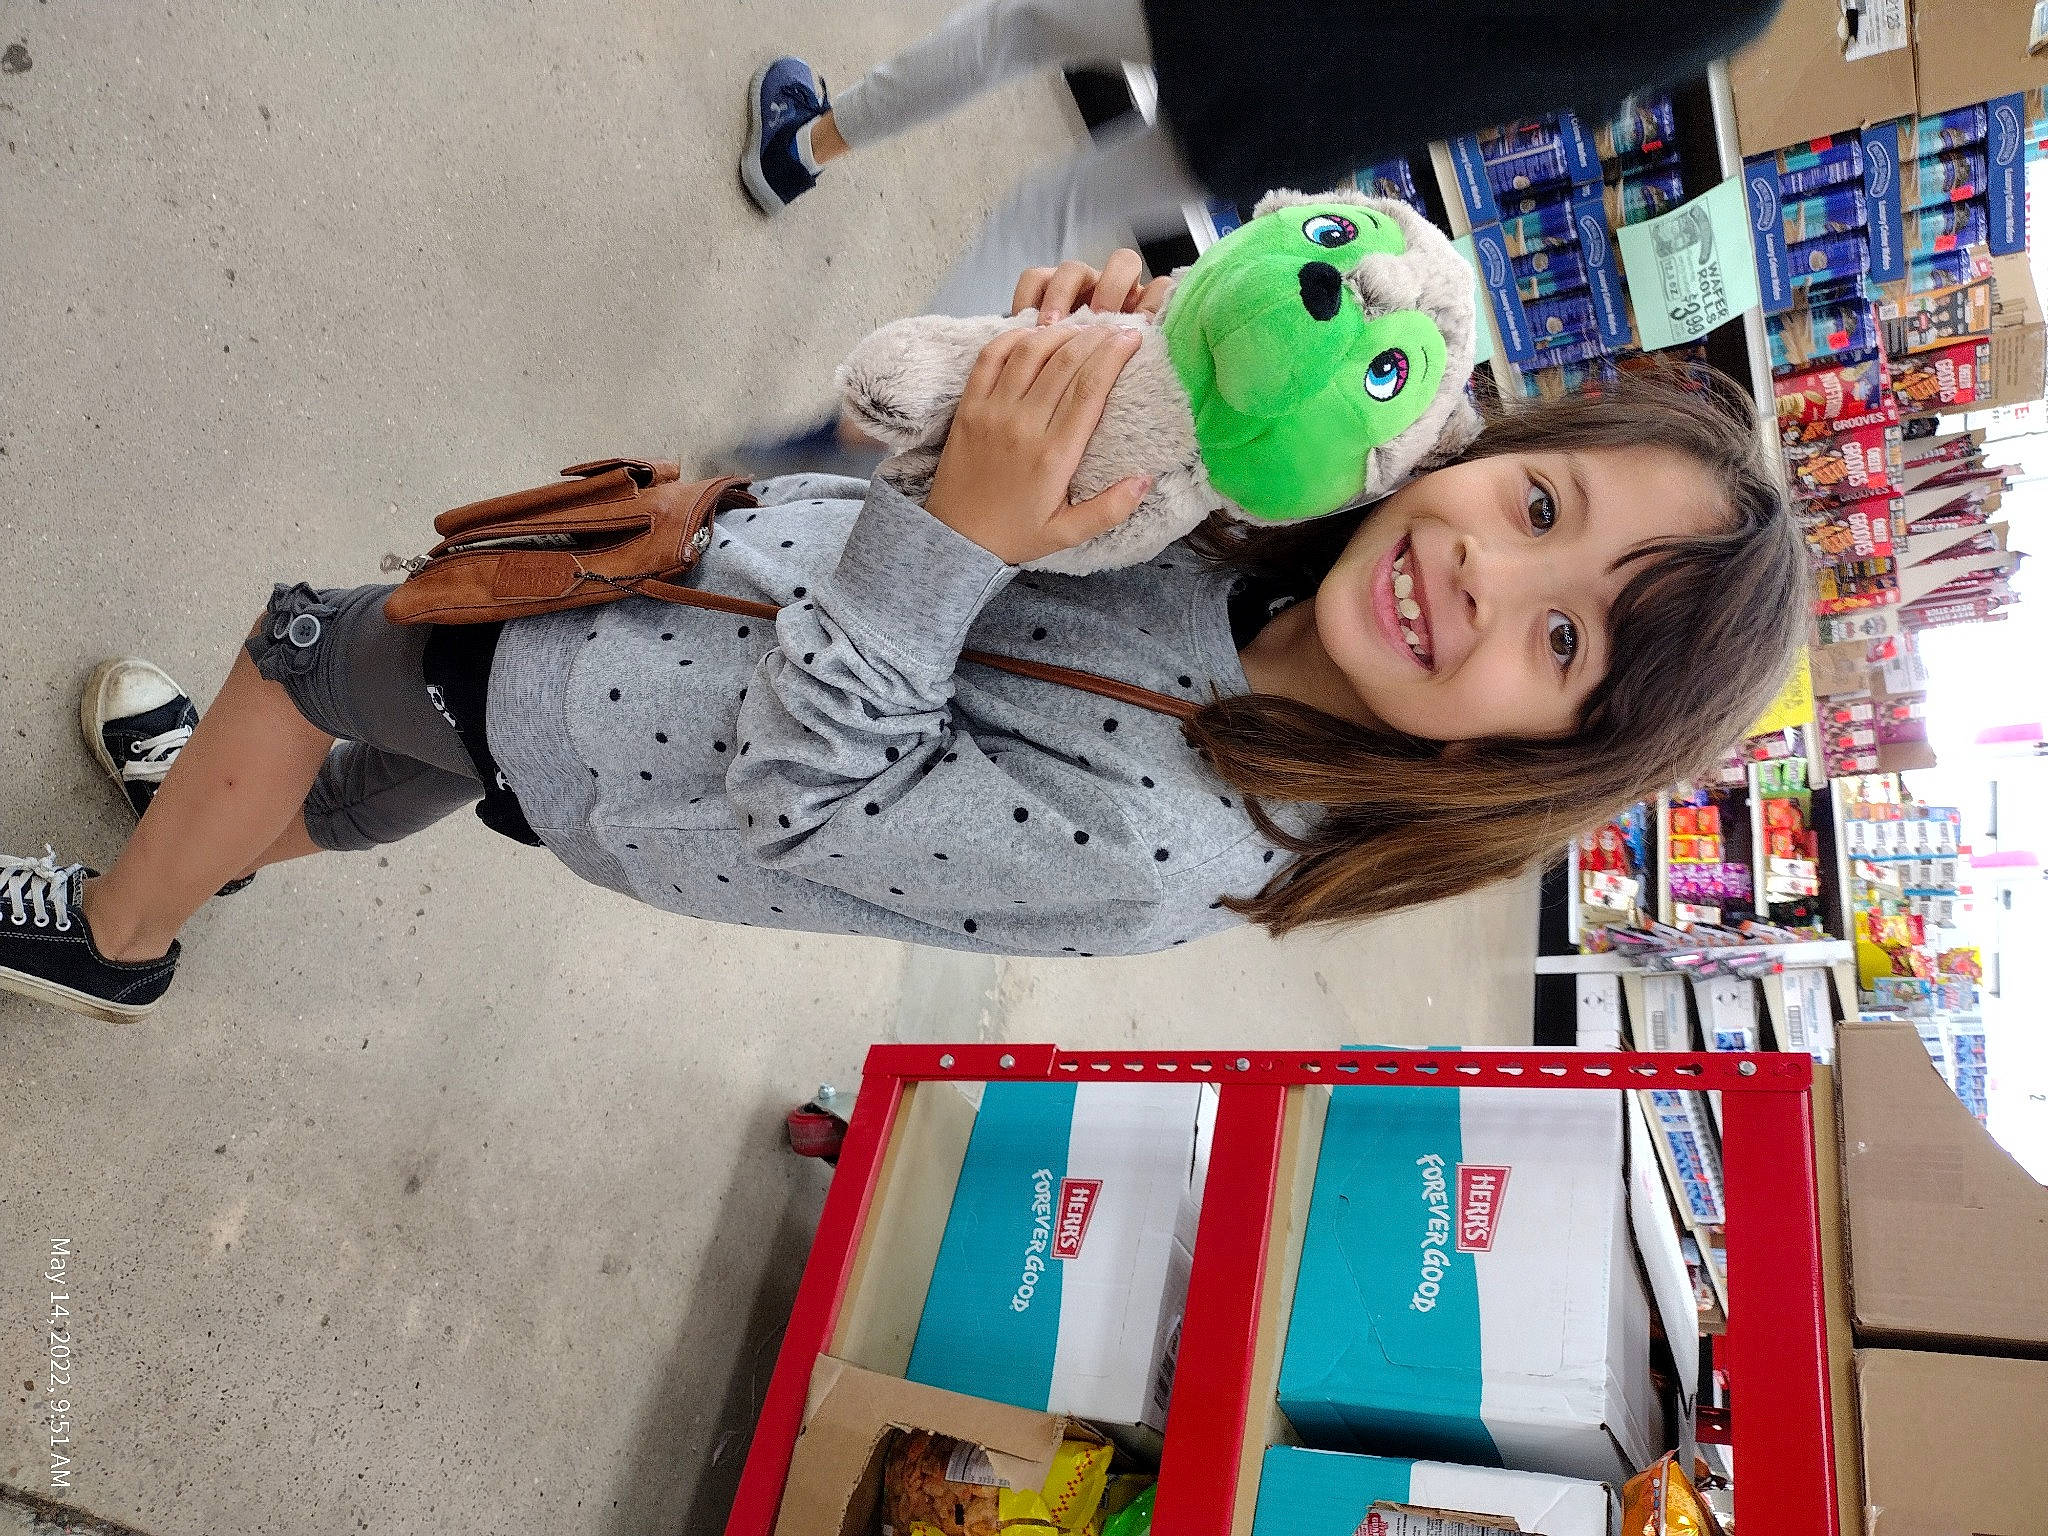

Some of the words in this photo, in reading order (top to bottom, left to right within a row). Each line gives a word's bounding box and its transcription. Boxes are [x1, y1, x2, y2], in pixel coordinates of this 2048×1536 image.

[1697, 268, 1716, 324] ROLLS
[1708, 262, 1728, 316] WAFER
[1024, 1168, 1054, 1256] FOREVER
[1060, 1187, 1091, 1249] HERR'S
[1416, 1154, 1451, 1248] FOREVER
[1463, 1173, 1496, 1242] HERR'S
